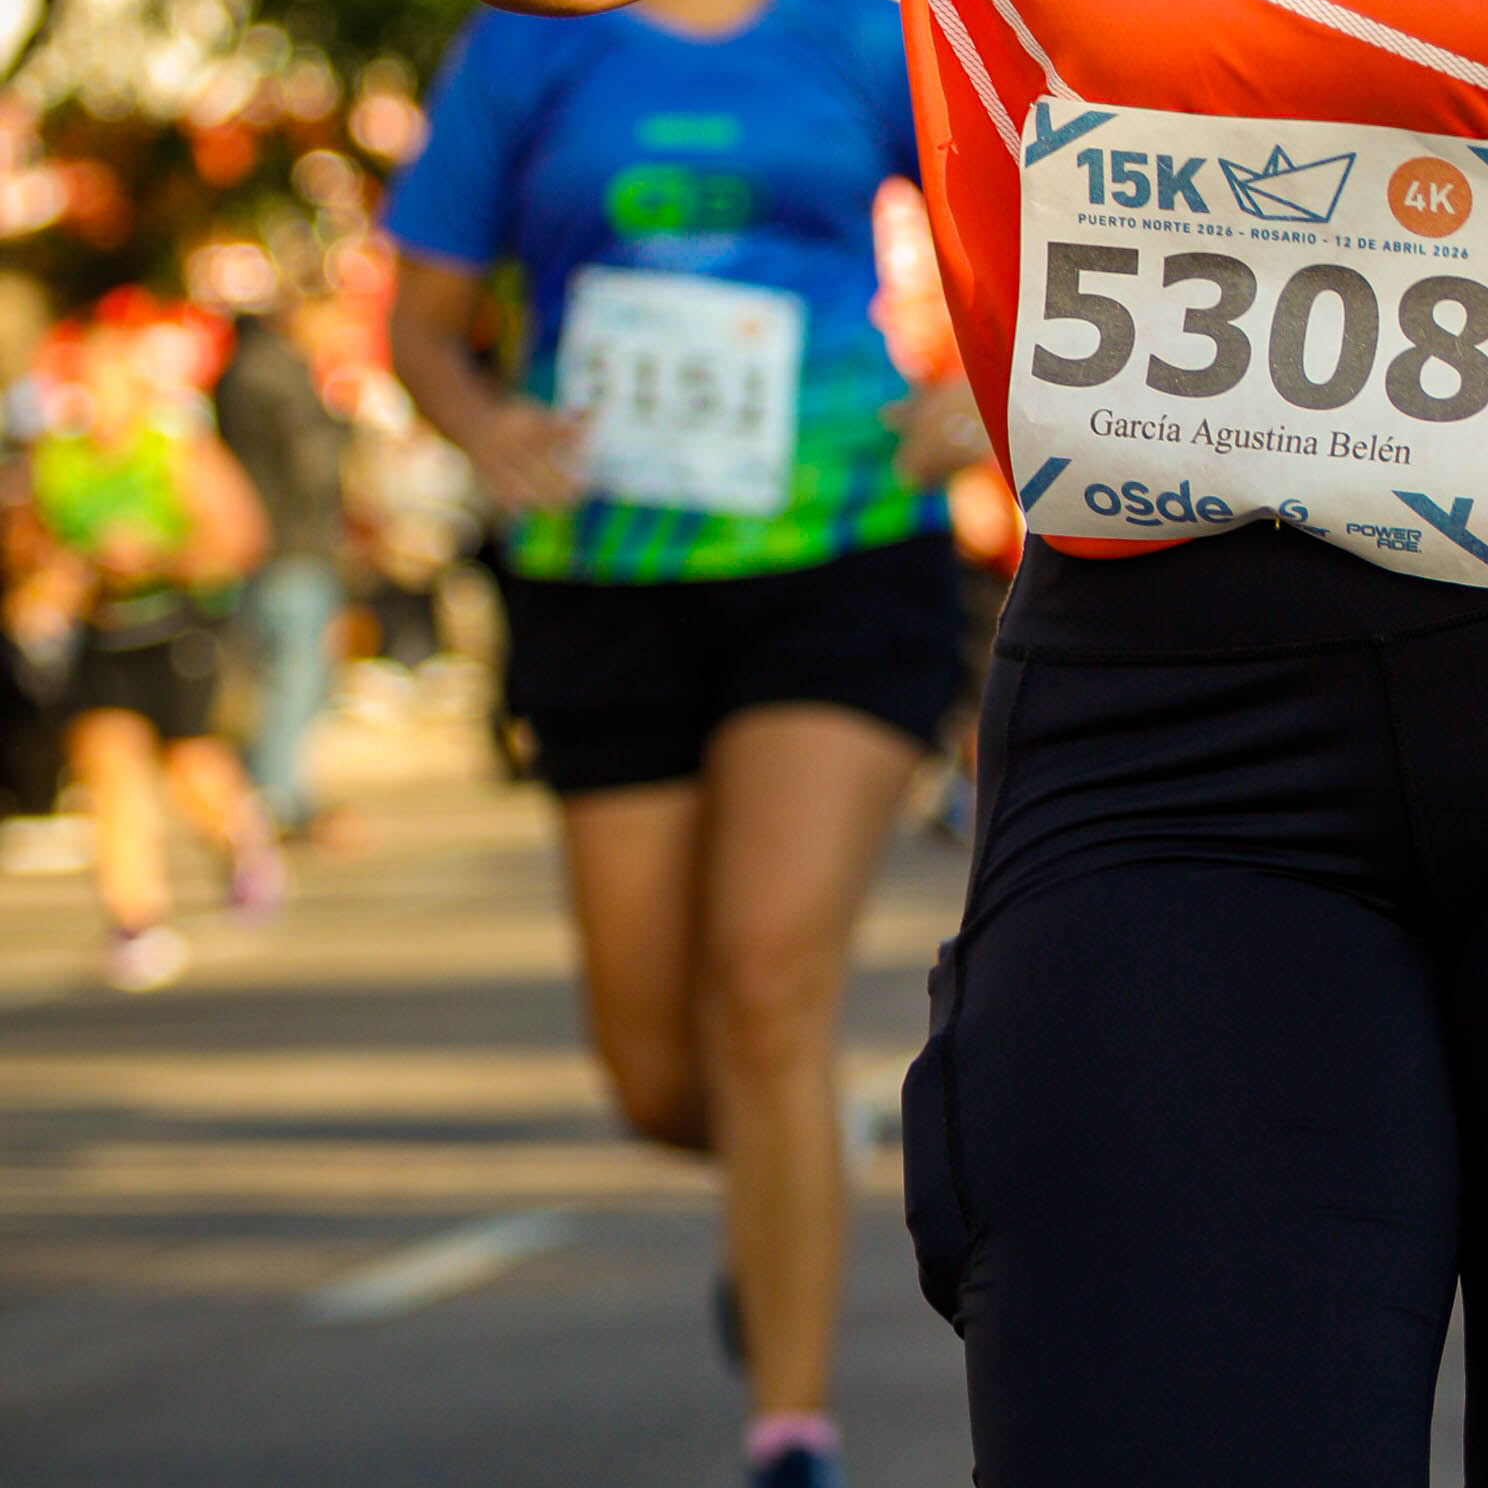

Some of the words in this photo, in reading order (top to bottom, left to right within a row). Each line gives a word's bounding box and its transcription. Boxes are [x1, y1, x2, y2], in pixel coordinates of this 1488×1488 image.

[1076, 148, 1211, 214] 15K
[1403, 181, 1456, 214] 4K
[1078, 213, 1137, 228] PUERTO
[1142, 218, 1191, 233] NORTE
[1197, 223, 1233, 237] 2026
[1251, 228, 1317, 245] ROSARIO
[1335, 235, 1352, 248] 12
[1358, 239, 1376, 251] DE
[1382, 243, 1427, 256] ABRIL
[1433, 245, 1470, 260] 2026
[1090, 408, 1182, 444] García
[1190, 418, 1318, 455] Agustina
[1328, 431, 1412, 465] Belén
[1084, 479, 1234, 527] osde
[1346, 522, 1422, 541] POWER
